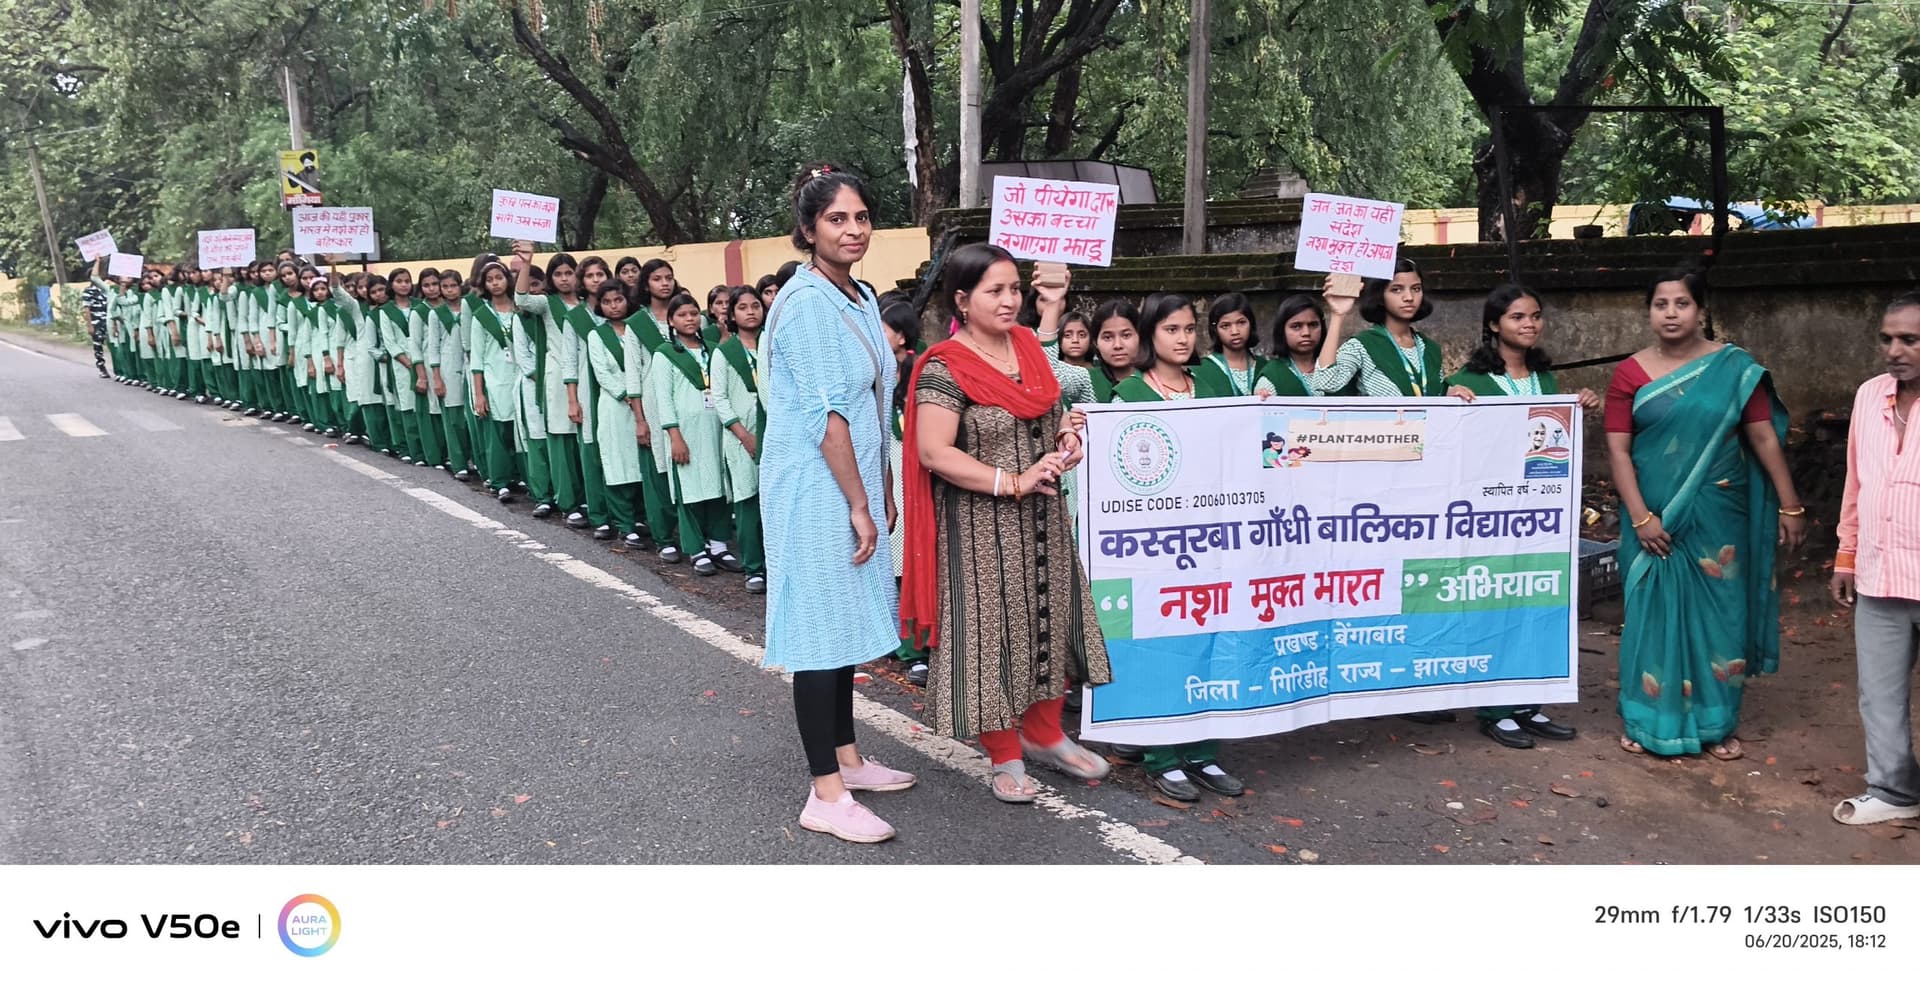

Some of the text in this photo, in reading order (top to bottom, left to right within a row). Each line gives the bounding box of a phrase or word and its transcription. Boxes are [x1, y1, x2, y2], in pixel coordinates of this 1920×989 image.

[1004, 182, 1027, 205] जो
[1000, 208, 1101, 230] उसका बच्चा
[1311, 200, 1395, 223] जन जन का यही
[1306, 236, 1328, 251] नशा
[1355, 238, 1369, 257] हो
[1367, 243, 1393, 260] अपना
[1330, 256, 1355, 272] देश
[1296, 434, 1420, 444] #PLANT4MOTHER
[1482, 482, 1514, 497] स्थापित
[1517, 480, 1529, 495] वर्ष
[1540, 484, 1562, 494] 2005
[1101, 499, 1143, 513] UDISE
[1147, 497, 1183, 511] CODE
[1193, 491, 1265, 508] 20060103705
[1098, 500, 1564, 570] कस्तूरबा गाँधी बालिका विद्यालय
[1159, 581, 1232, 627] नशा
[1249, 572, 1306, 623] मुक्त
[1314, 568, 1385, 607] भारत
[1436, 565, 1563, 602] अभियान
[1273, 630, 1319, 657] प्रखण्ड
[1333, 621, 1407, 647] बेंगाबाद
[1184, 675, 1240, 705] जिला
[1270, 662, 1329, 696] गिरिडीह
[1337, 661, 1382, 683] राज्य
[1413, 654, 1493, 678] झारखण्ड
